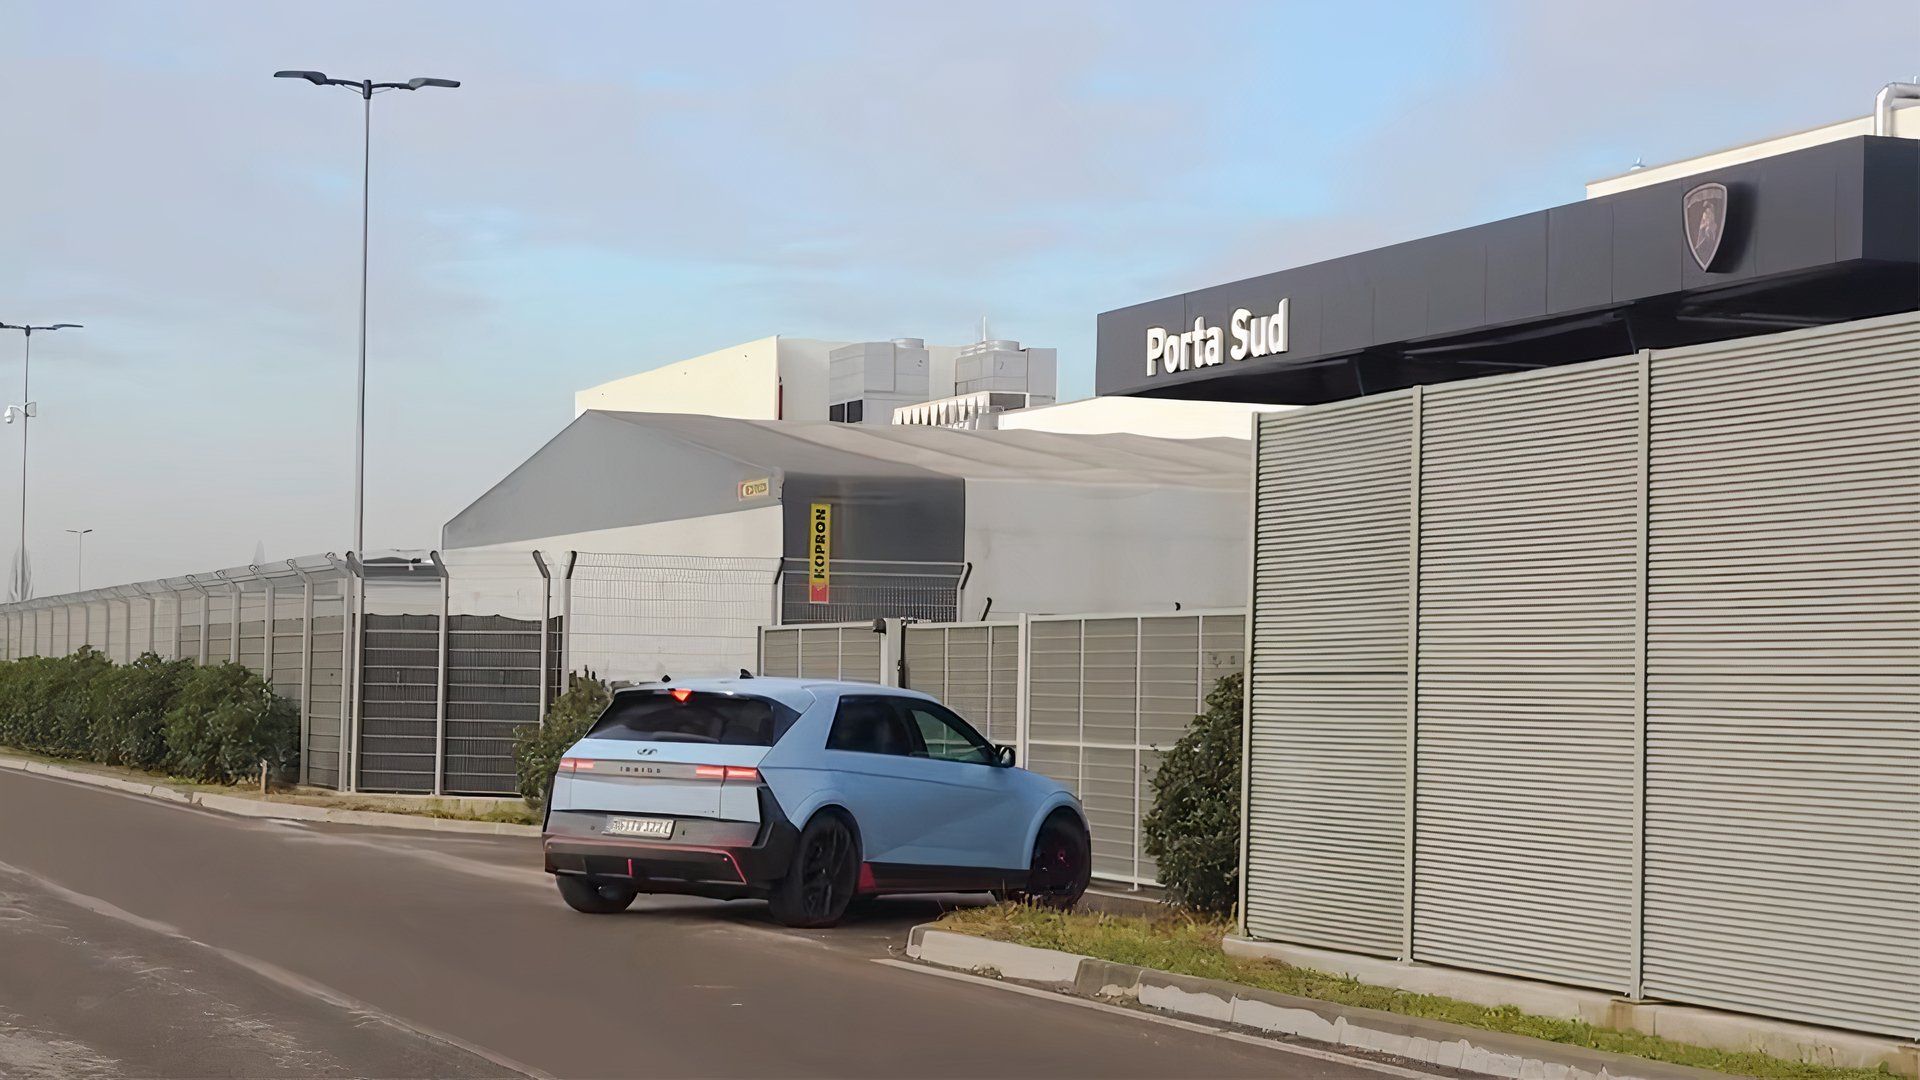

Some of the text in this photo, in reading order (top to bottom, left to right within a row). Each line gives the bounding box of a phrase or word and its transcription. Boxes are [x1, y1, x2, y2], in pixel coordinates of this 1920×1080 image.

[1146, 297, 1289, 377] Porta Sud
[814, 508, 826, 579] KOPRON
